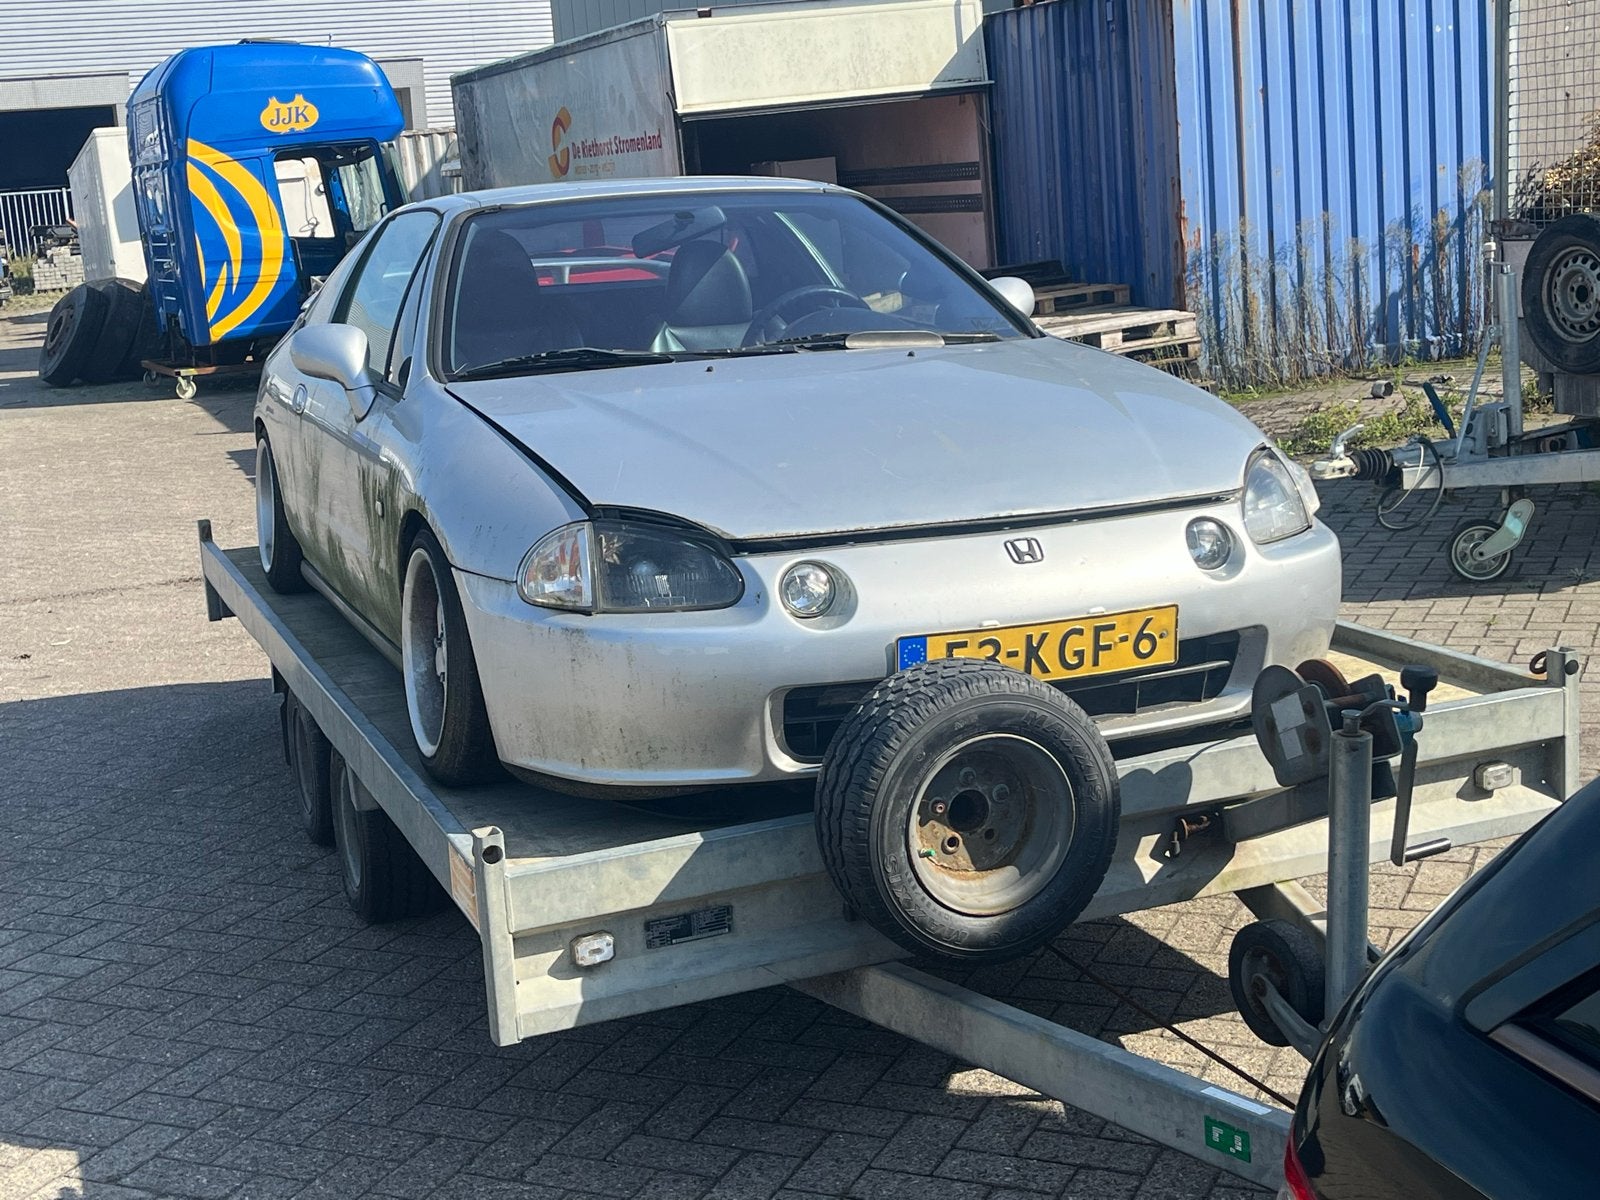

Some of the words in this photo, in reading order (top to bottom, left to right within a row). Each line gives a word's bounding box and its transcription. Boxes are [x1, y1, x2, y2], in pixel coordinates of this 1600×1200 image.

[270, 105, 310, 126] JJK
[572, 141, 581, 159] De
[581, 137, 614, 158] Riethorst
[613, 128, 662, 155] Stromenland
[883, 854, 970, 945] MAXXIS
